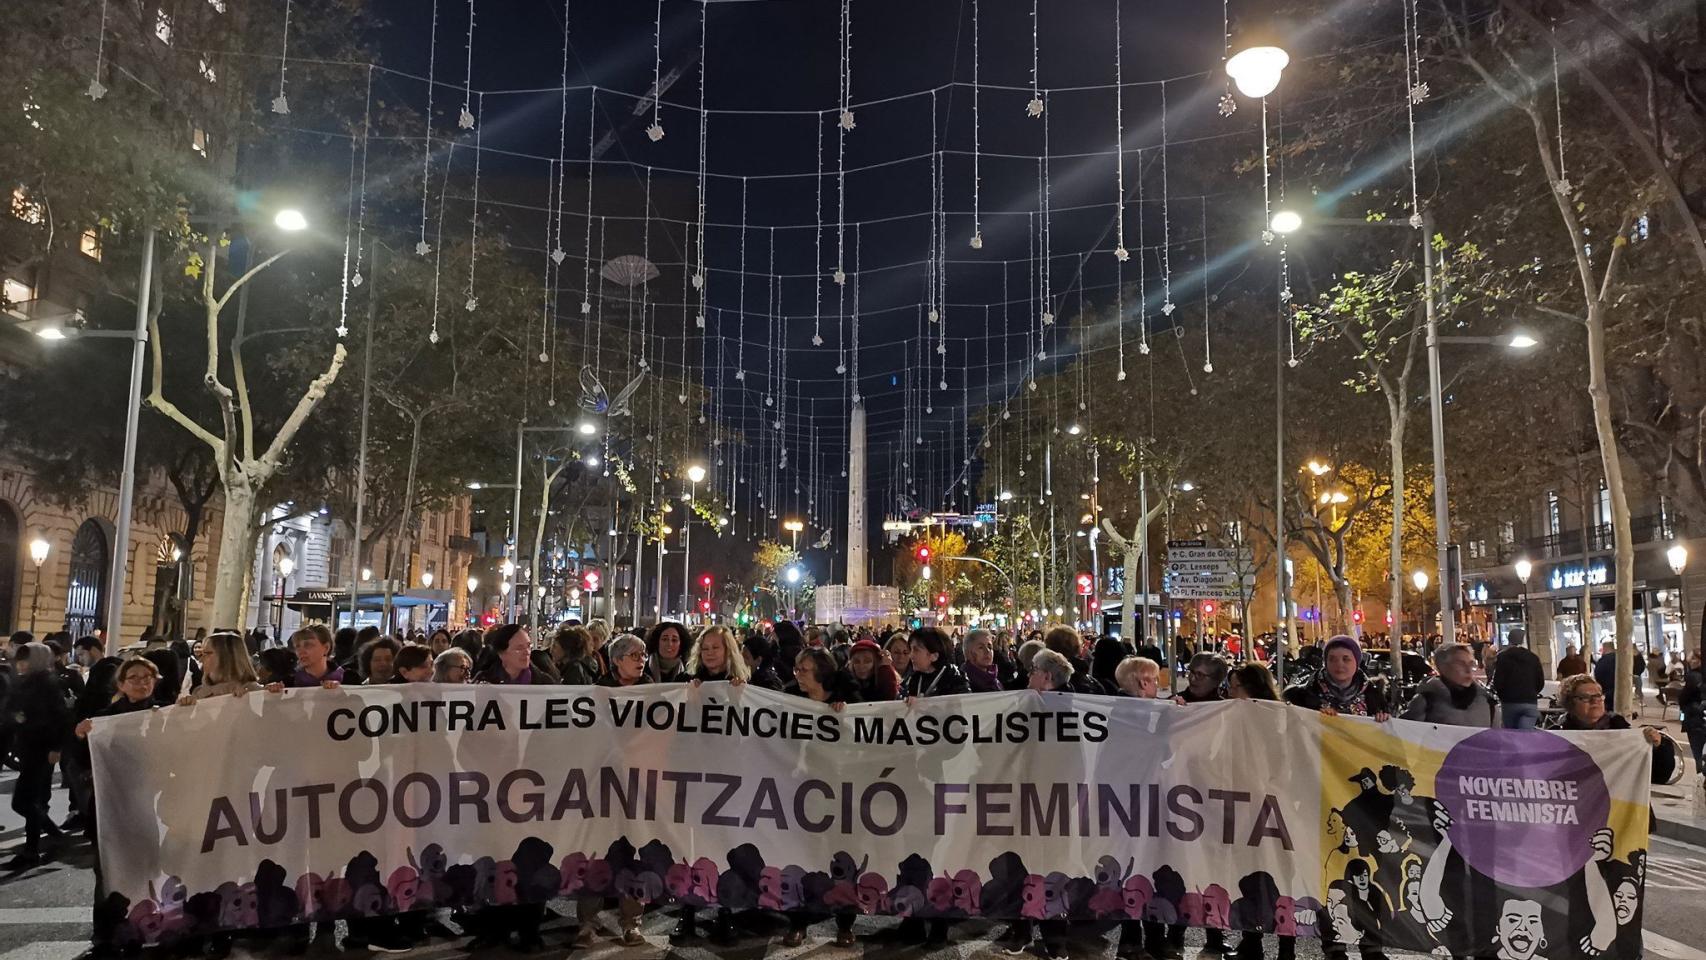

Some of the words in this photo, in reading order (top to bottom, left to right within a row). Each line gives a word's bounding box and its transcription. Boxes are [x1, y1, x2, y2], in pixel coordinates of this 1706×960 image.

[1189, 550, 1205, 558] Gran
[1190, 563, 1219, 571] Lesseps
[1193, 576, 1224, 584] Diagonal
[326, 700, 507, 741] CONTRA
[519, 697, 596, 730] LES
[608, 697, 841, 743] VIOLÈNCIES
[854, 711, 1109, 746] MASCLISTES
[1458, 775, 1579, 800] NOVEMBRE
[201, 767, 908, 854] AUTOORGANITZACIÓ
[933, 783, 1295, 852] FEMINISTA
[1466, 799, 1579, 825] FEMINISTA
